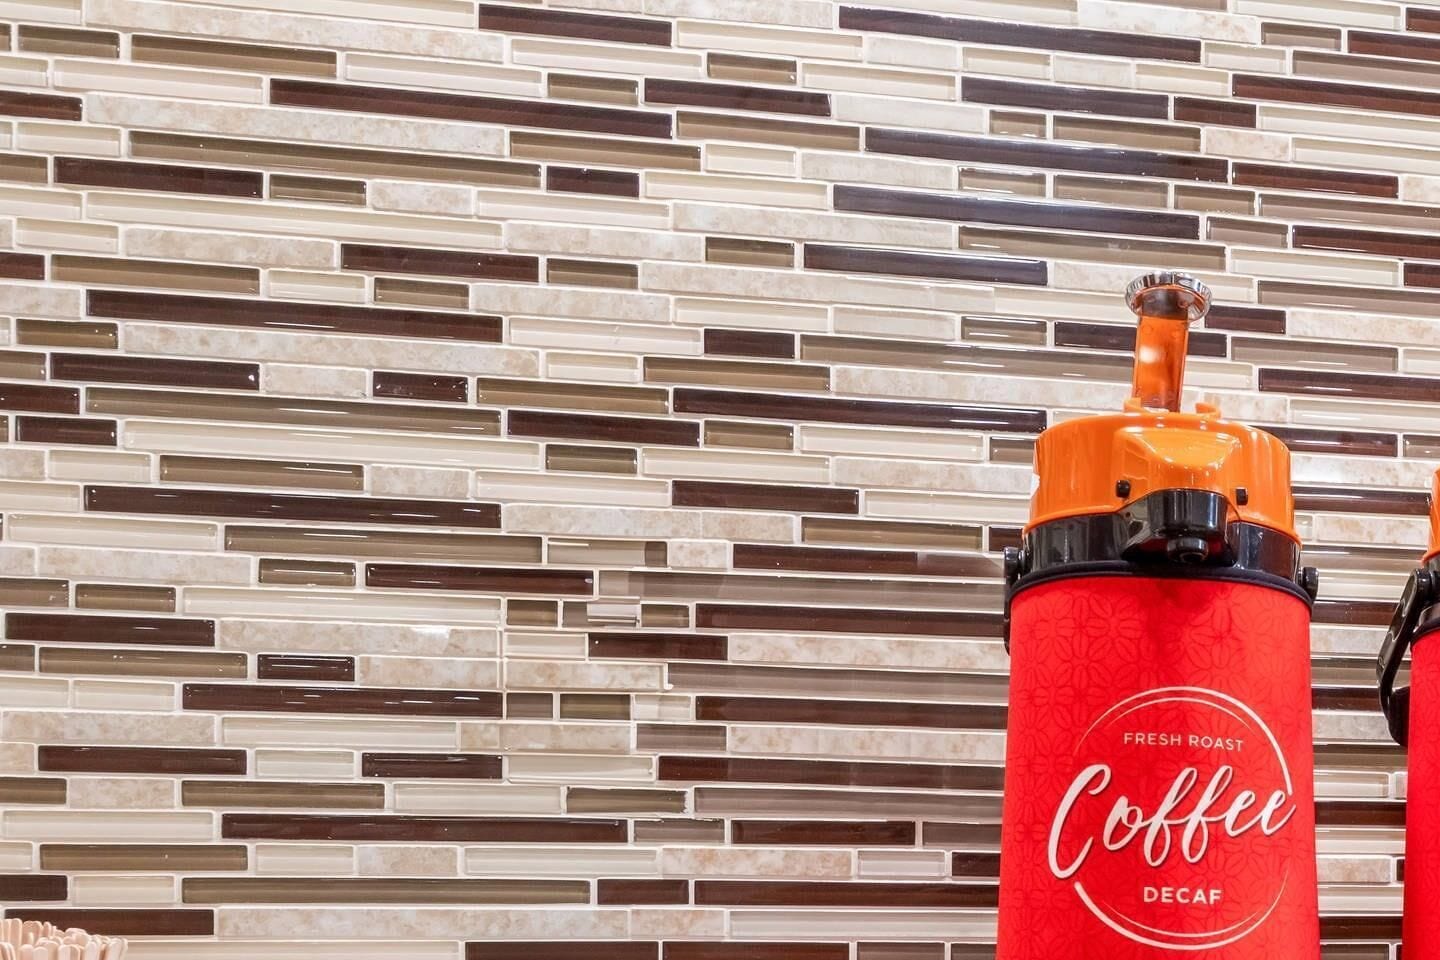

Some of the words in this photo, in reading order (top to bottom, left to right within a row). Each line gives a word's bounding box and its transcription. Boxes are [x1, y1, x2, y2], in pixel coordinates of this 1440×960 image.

[1123, 732, 1182, 746] FRESH
[1189, 735, 1244, 752] ROAST
[1047, 763, 1297, 881] Coffee
[1142, 886, 1222, 905] DECAF
